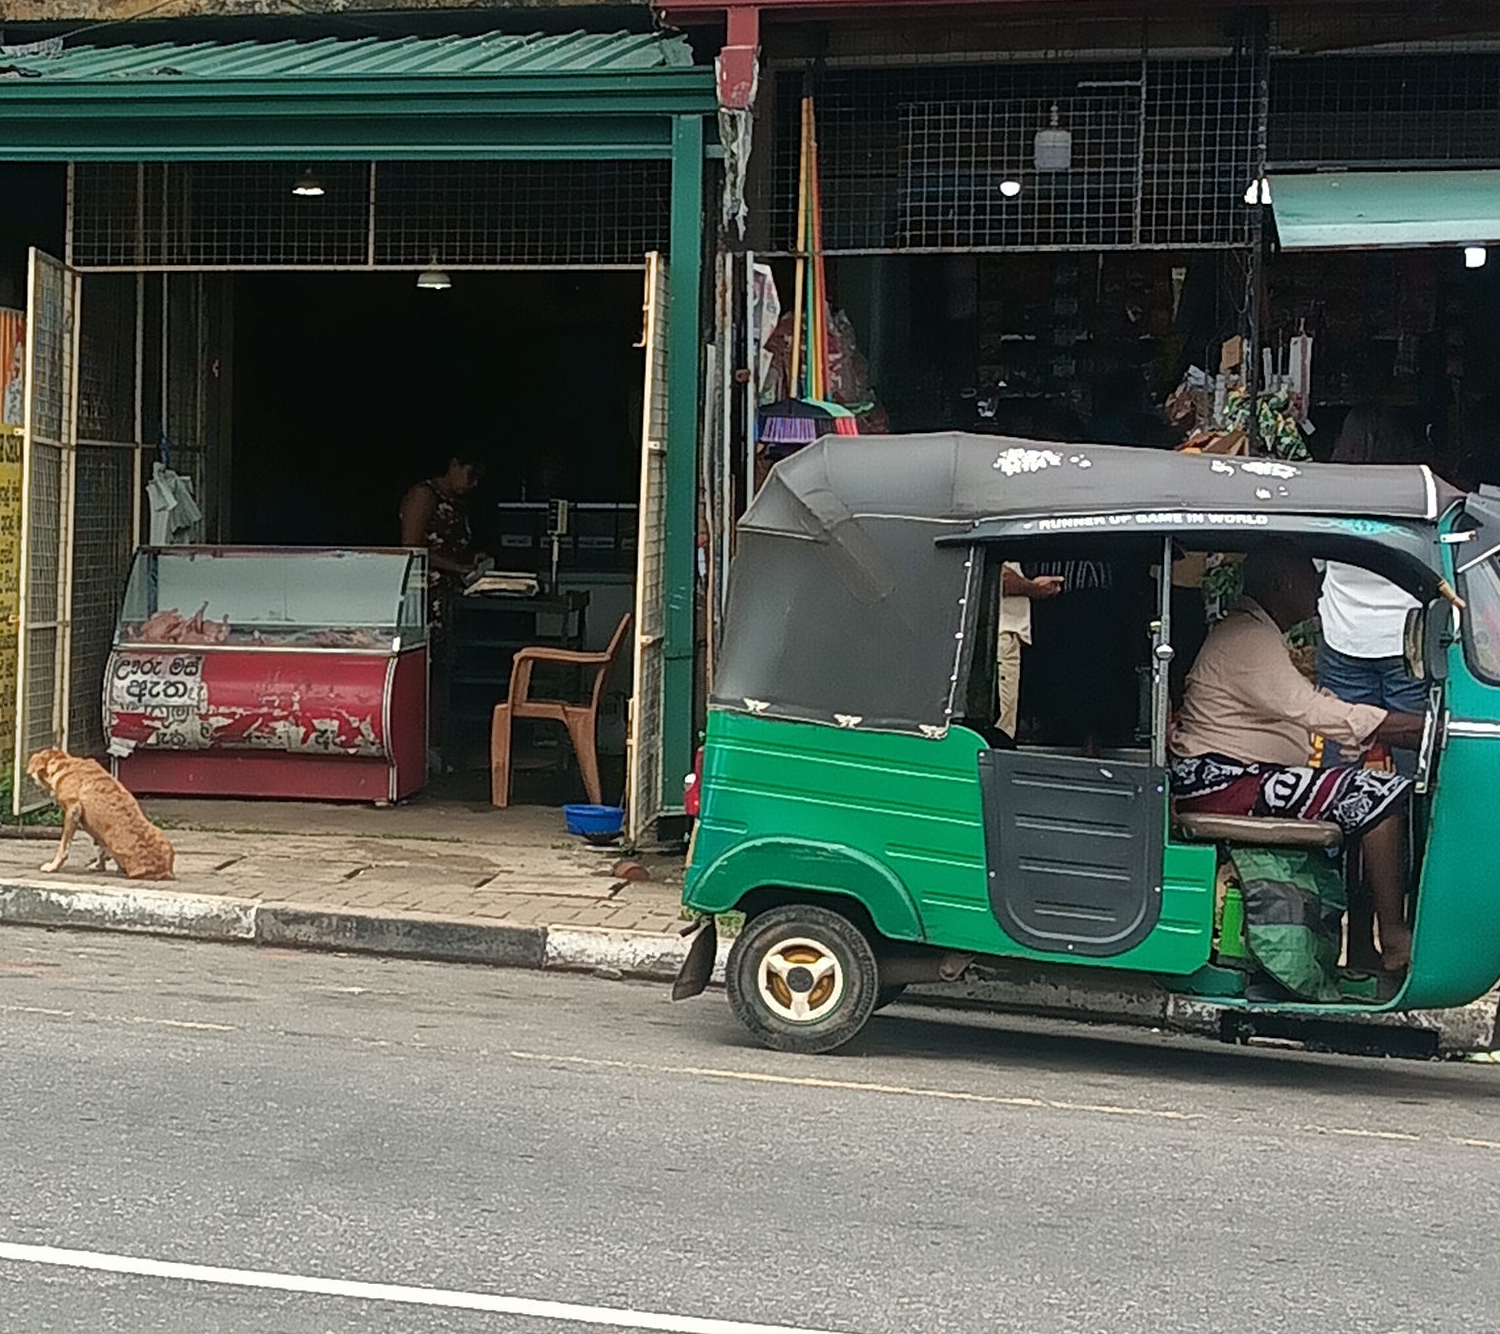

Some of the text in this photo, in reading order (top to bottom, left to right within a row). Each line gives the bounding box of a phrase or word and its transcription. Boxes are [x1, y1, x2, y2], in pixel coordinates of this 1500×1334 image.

[1038, 516, 1105, 530] RUNNER
[1136, 513, 1183, 524] GAME
[1208, 513, 1269, 526] WORLD
